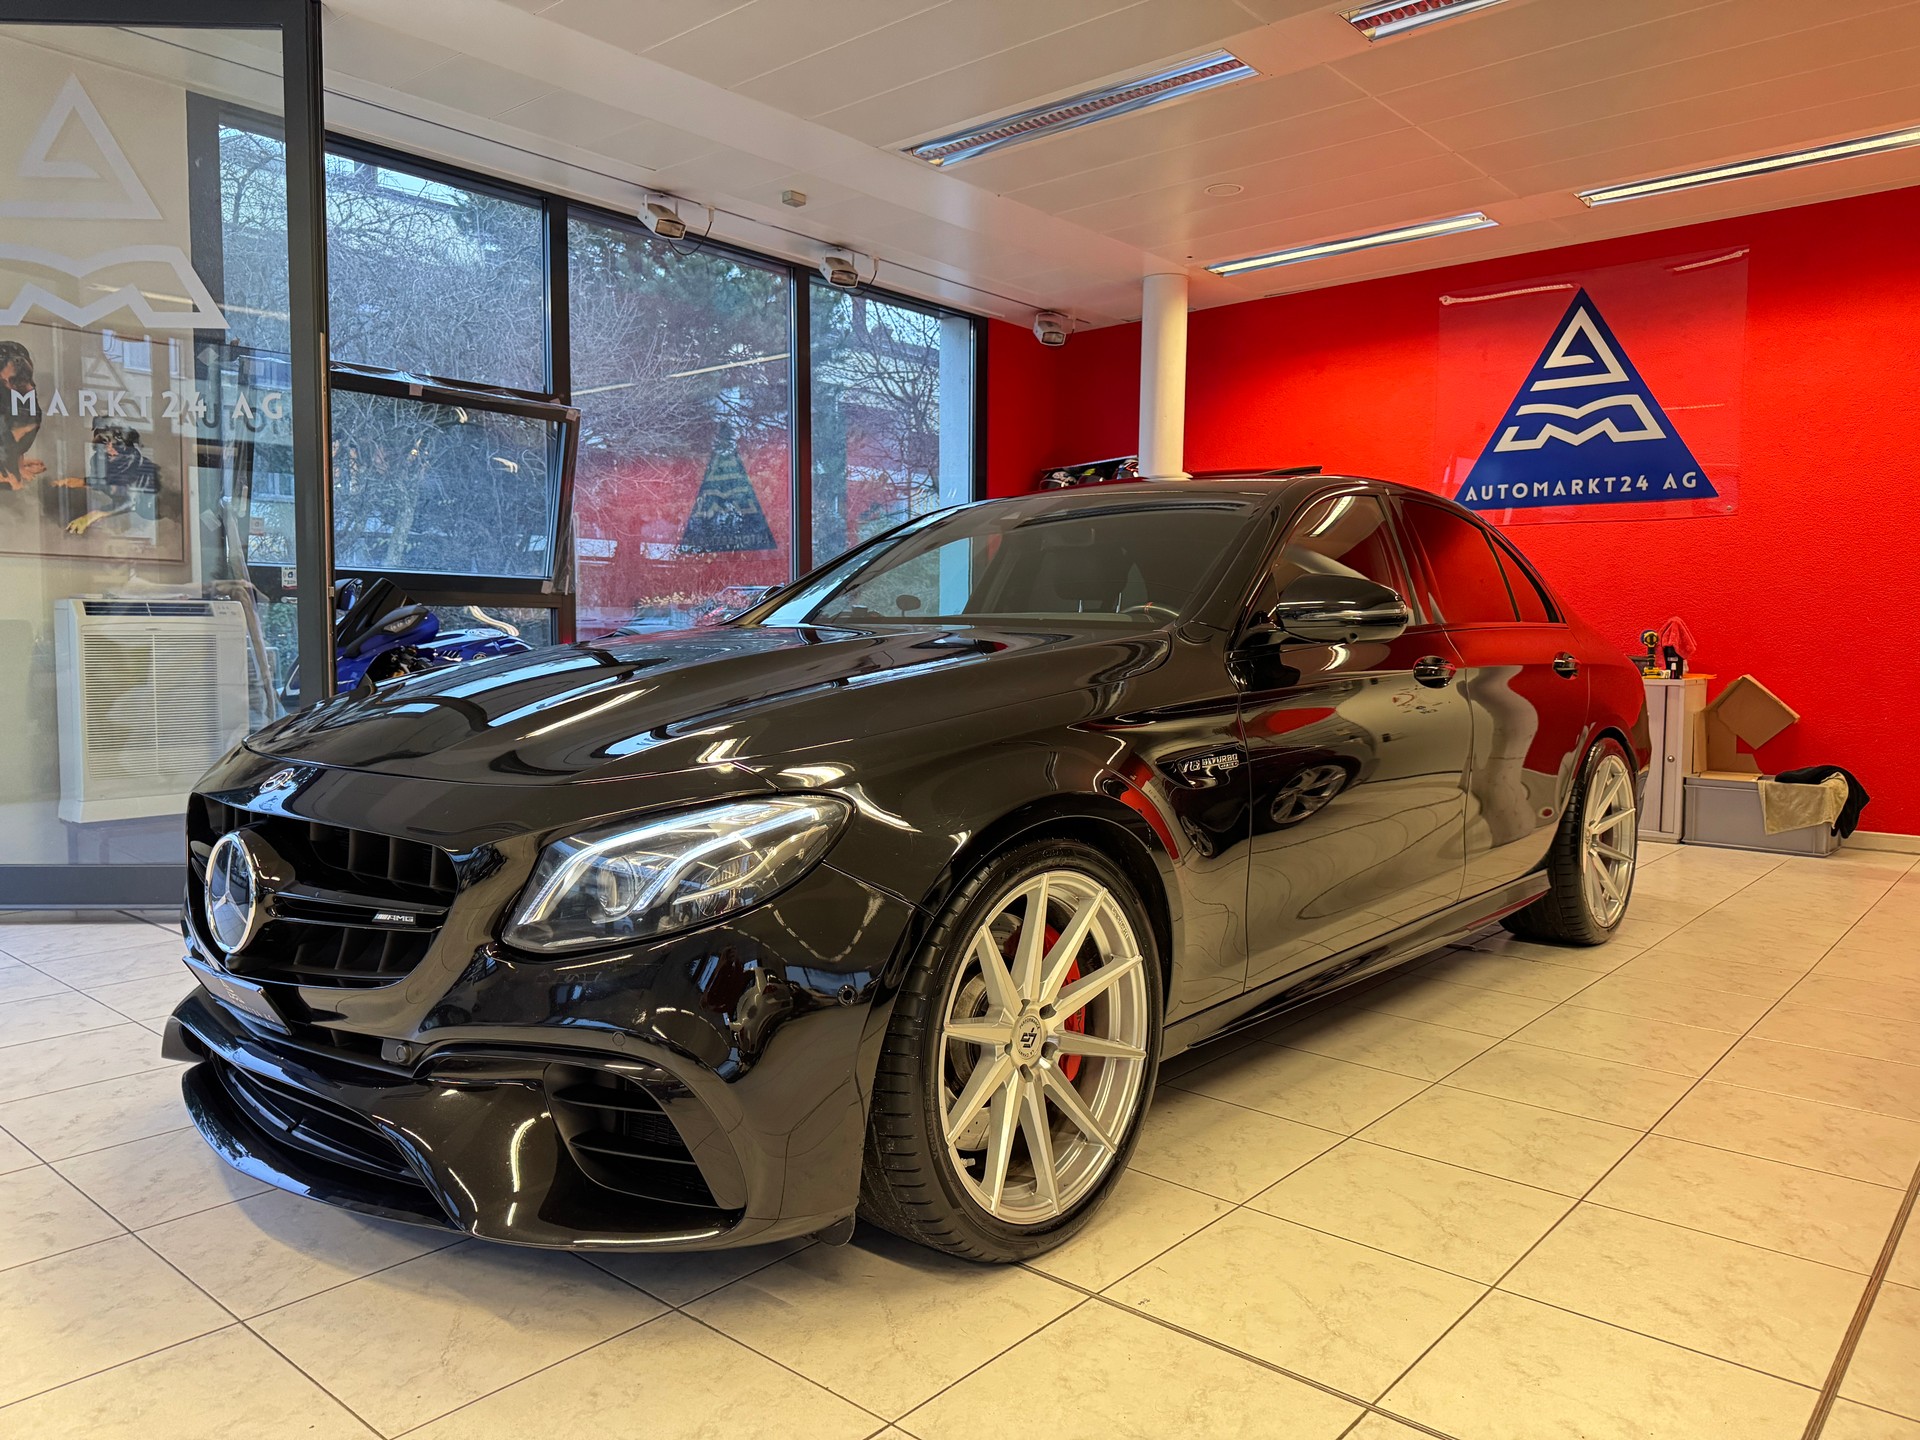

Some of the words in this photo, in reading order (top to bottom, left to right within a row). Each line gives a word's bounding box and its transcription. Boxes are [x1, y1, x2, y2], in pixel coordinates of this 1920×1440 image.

[11, 389, 207, 419] MARKT24
[231, 391, 283, 420] AG
[1465, 475, 1649, 501] AUTOMARKT24
[1663, 471, 1697, 490] AG
[387, 914, 414, 922] AMG
